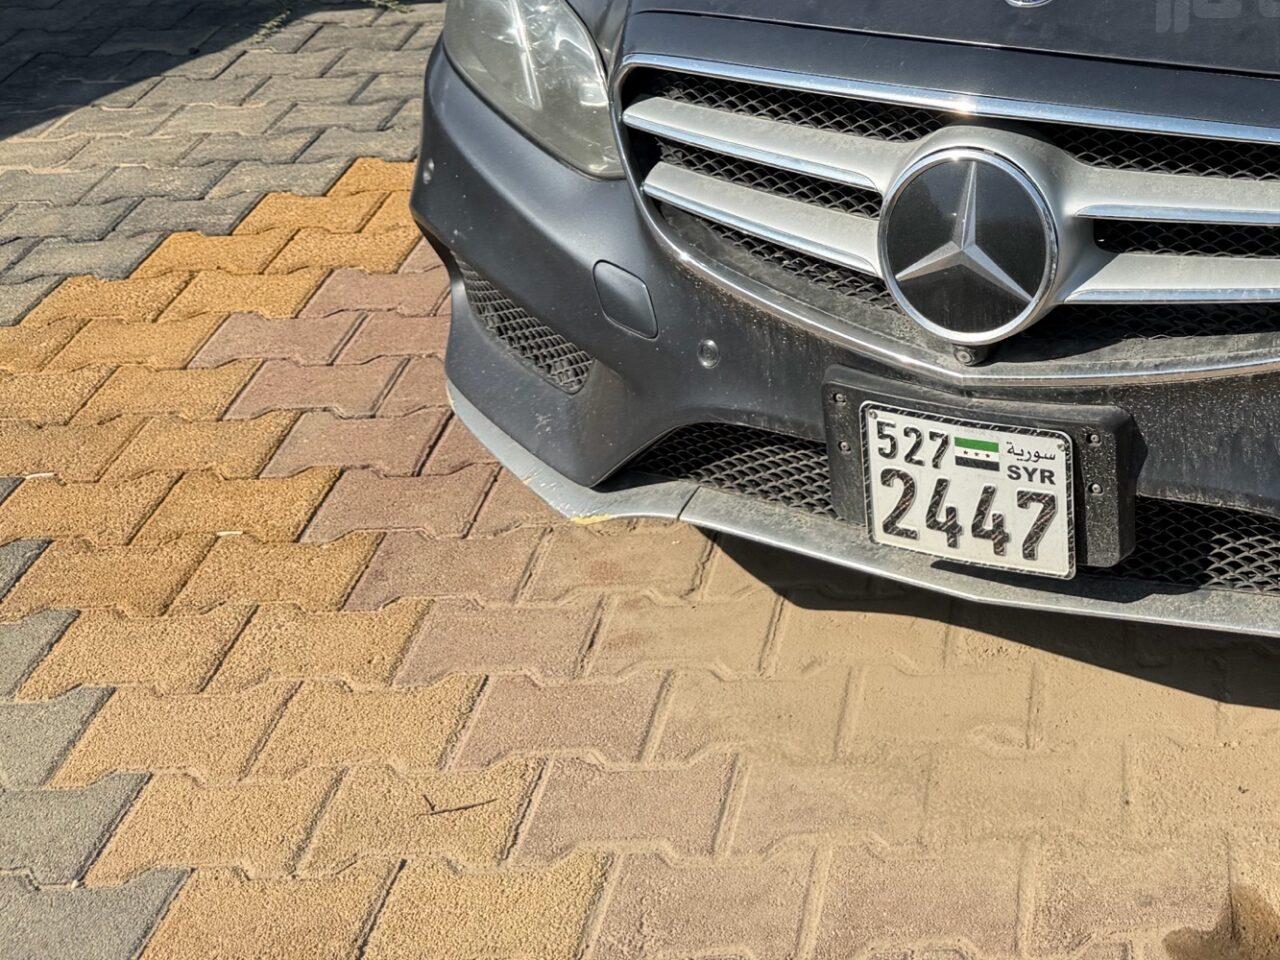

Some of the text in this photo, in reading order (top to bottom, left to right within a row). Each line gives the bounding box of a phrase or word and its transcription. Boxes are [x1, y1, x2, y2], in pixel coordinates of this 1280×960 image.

[877, 420, 950, 469] 527
[1006, 441, 1056, 462] سورية
[1007, 465, 1056, 485] SYR
[880, 468, 1057, 561] 2447
